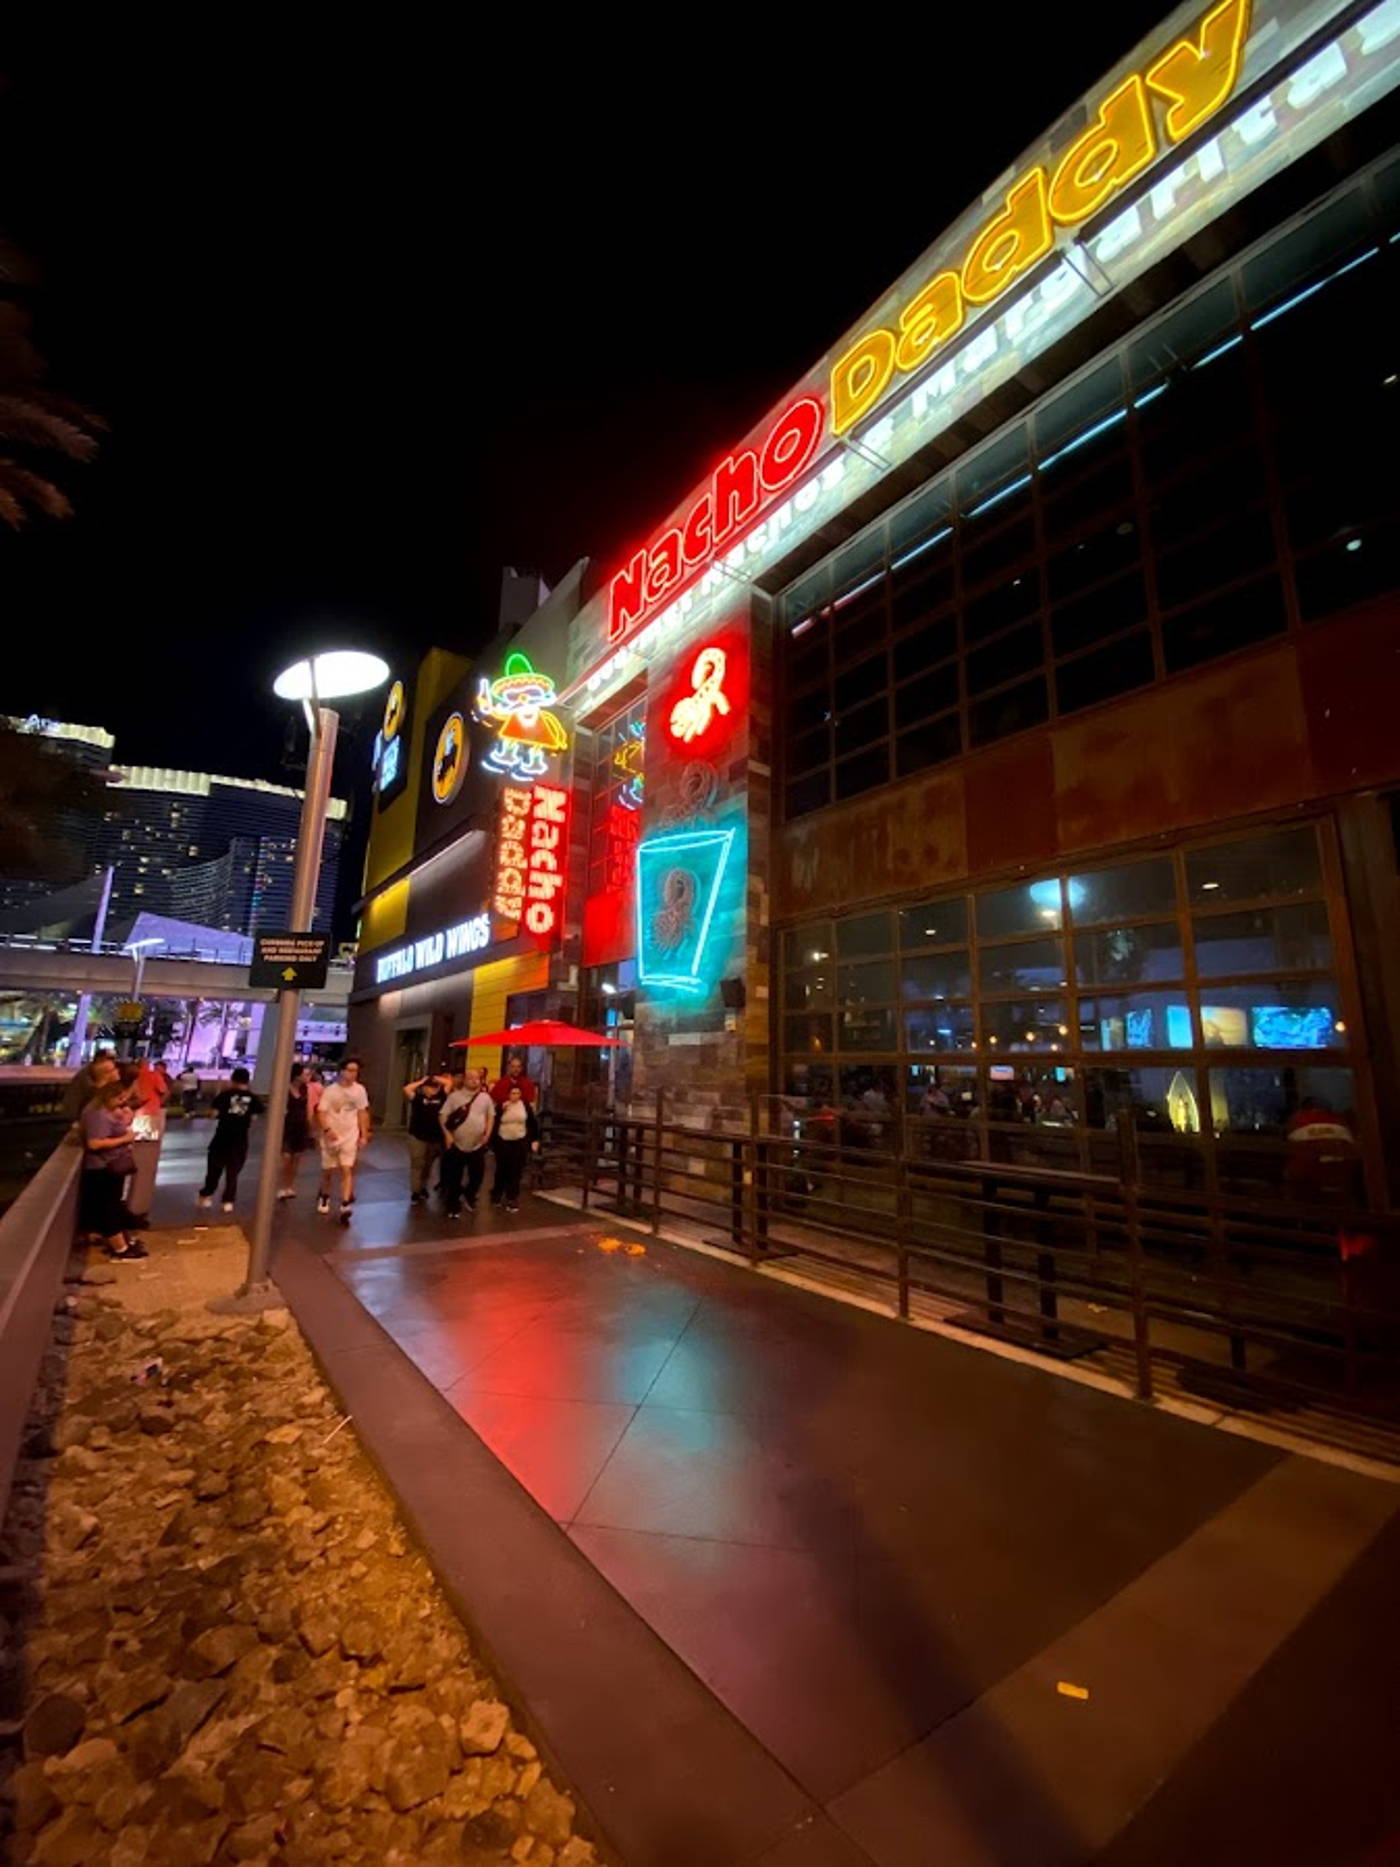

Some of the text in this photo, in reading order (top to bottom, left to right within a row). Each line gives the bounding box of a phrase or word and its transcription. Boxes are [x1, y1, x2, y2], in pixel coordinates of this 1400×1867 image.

[607, 0, 1253, 643] Nacho Daddy
[494, 786, 533, 921] Daddy
[525, 784, 567, 934] Nacho
[377, 912, 491, 983] BUFFALO WILD WINGS
